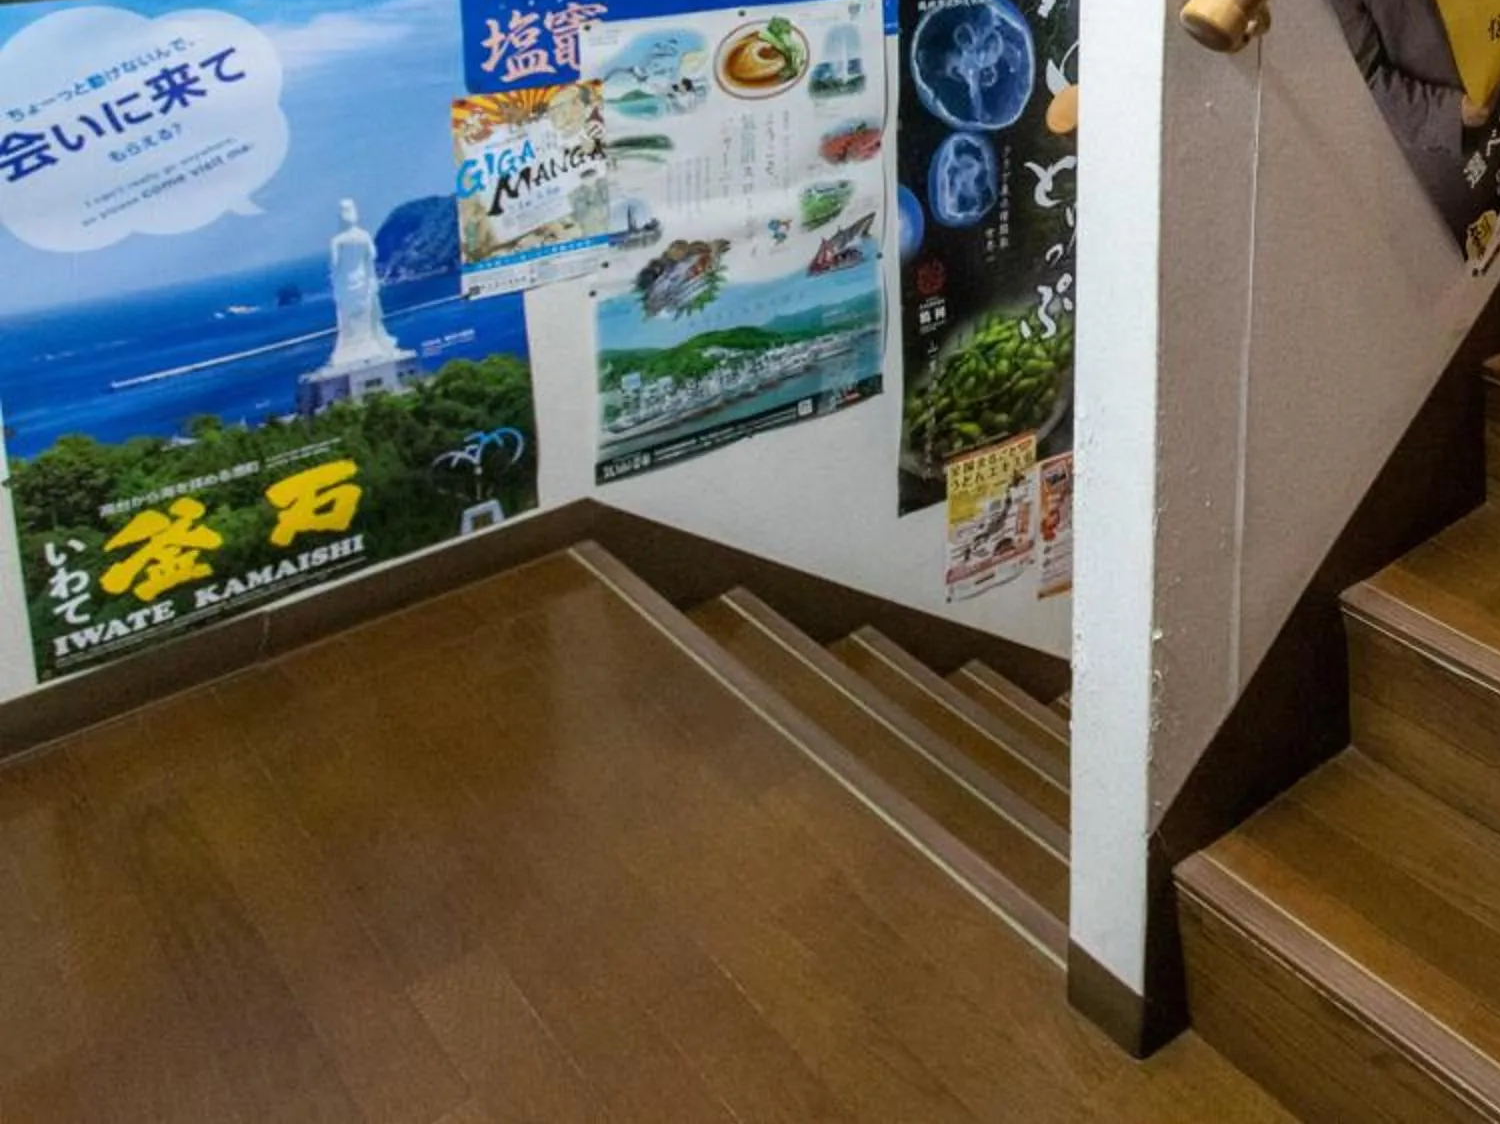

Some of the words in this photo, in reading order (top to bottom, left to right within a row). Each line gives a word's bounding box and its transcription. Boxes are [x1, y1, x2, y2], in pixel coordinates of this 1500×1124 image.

[0, 45, 246, 183] 会いに来て
[454, 138, 537, 199] GIGA
[486, 137, 608, 216] MANGA
[44, 538, 91, 625] いわて
[99, 458, 363, 603] 釜石
[53, 599, 177, 657] IWATE
[193, 533, 365, 609] KAMAISHI
